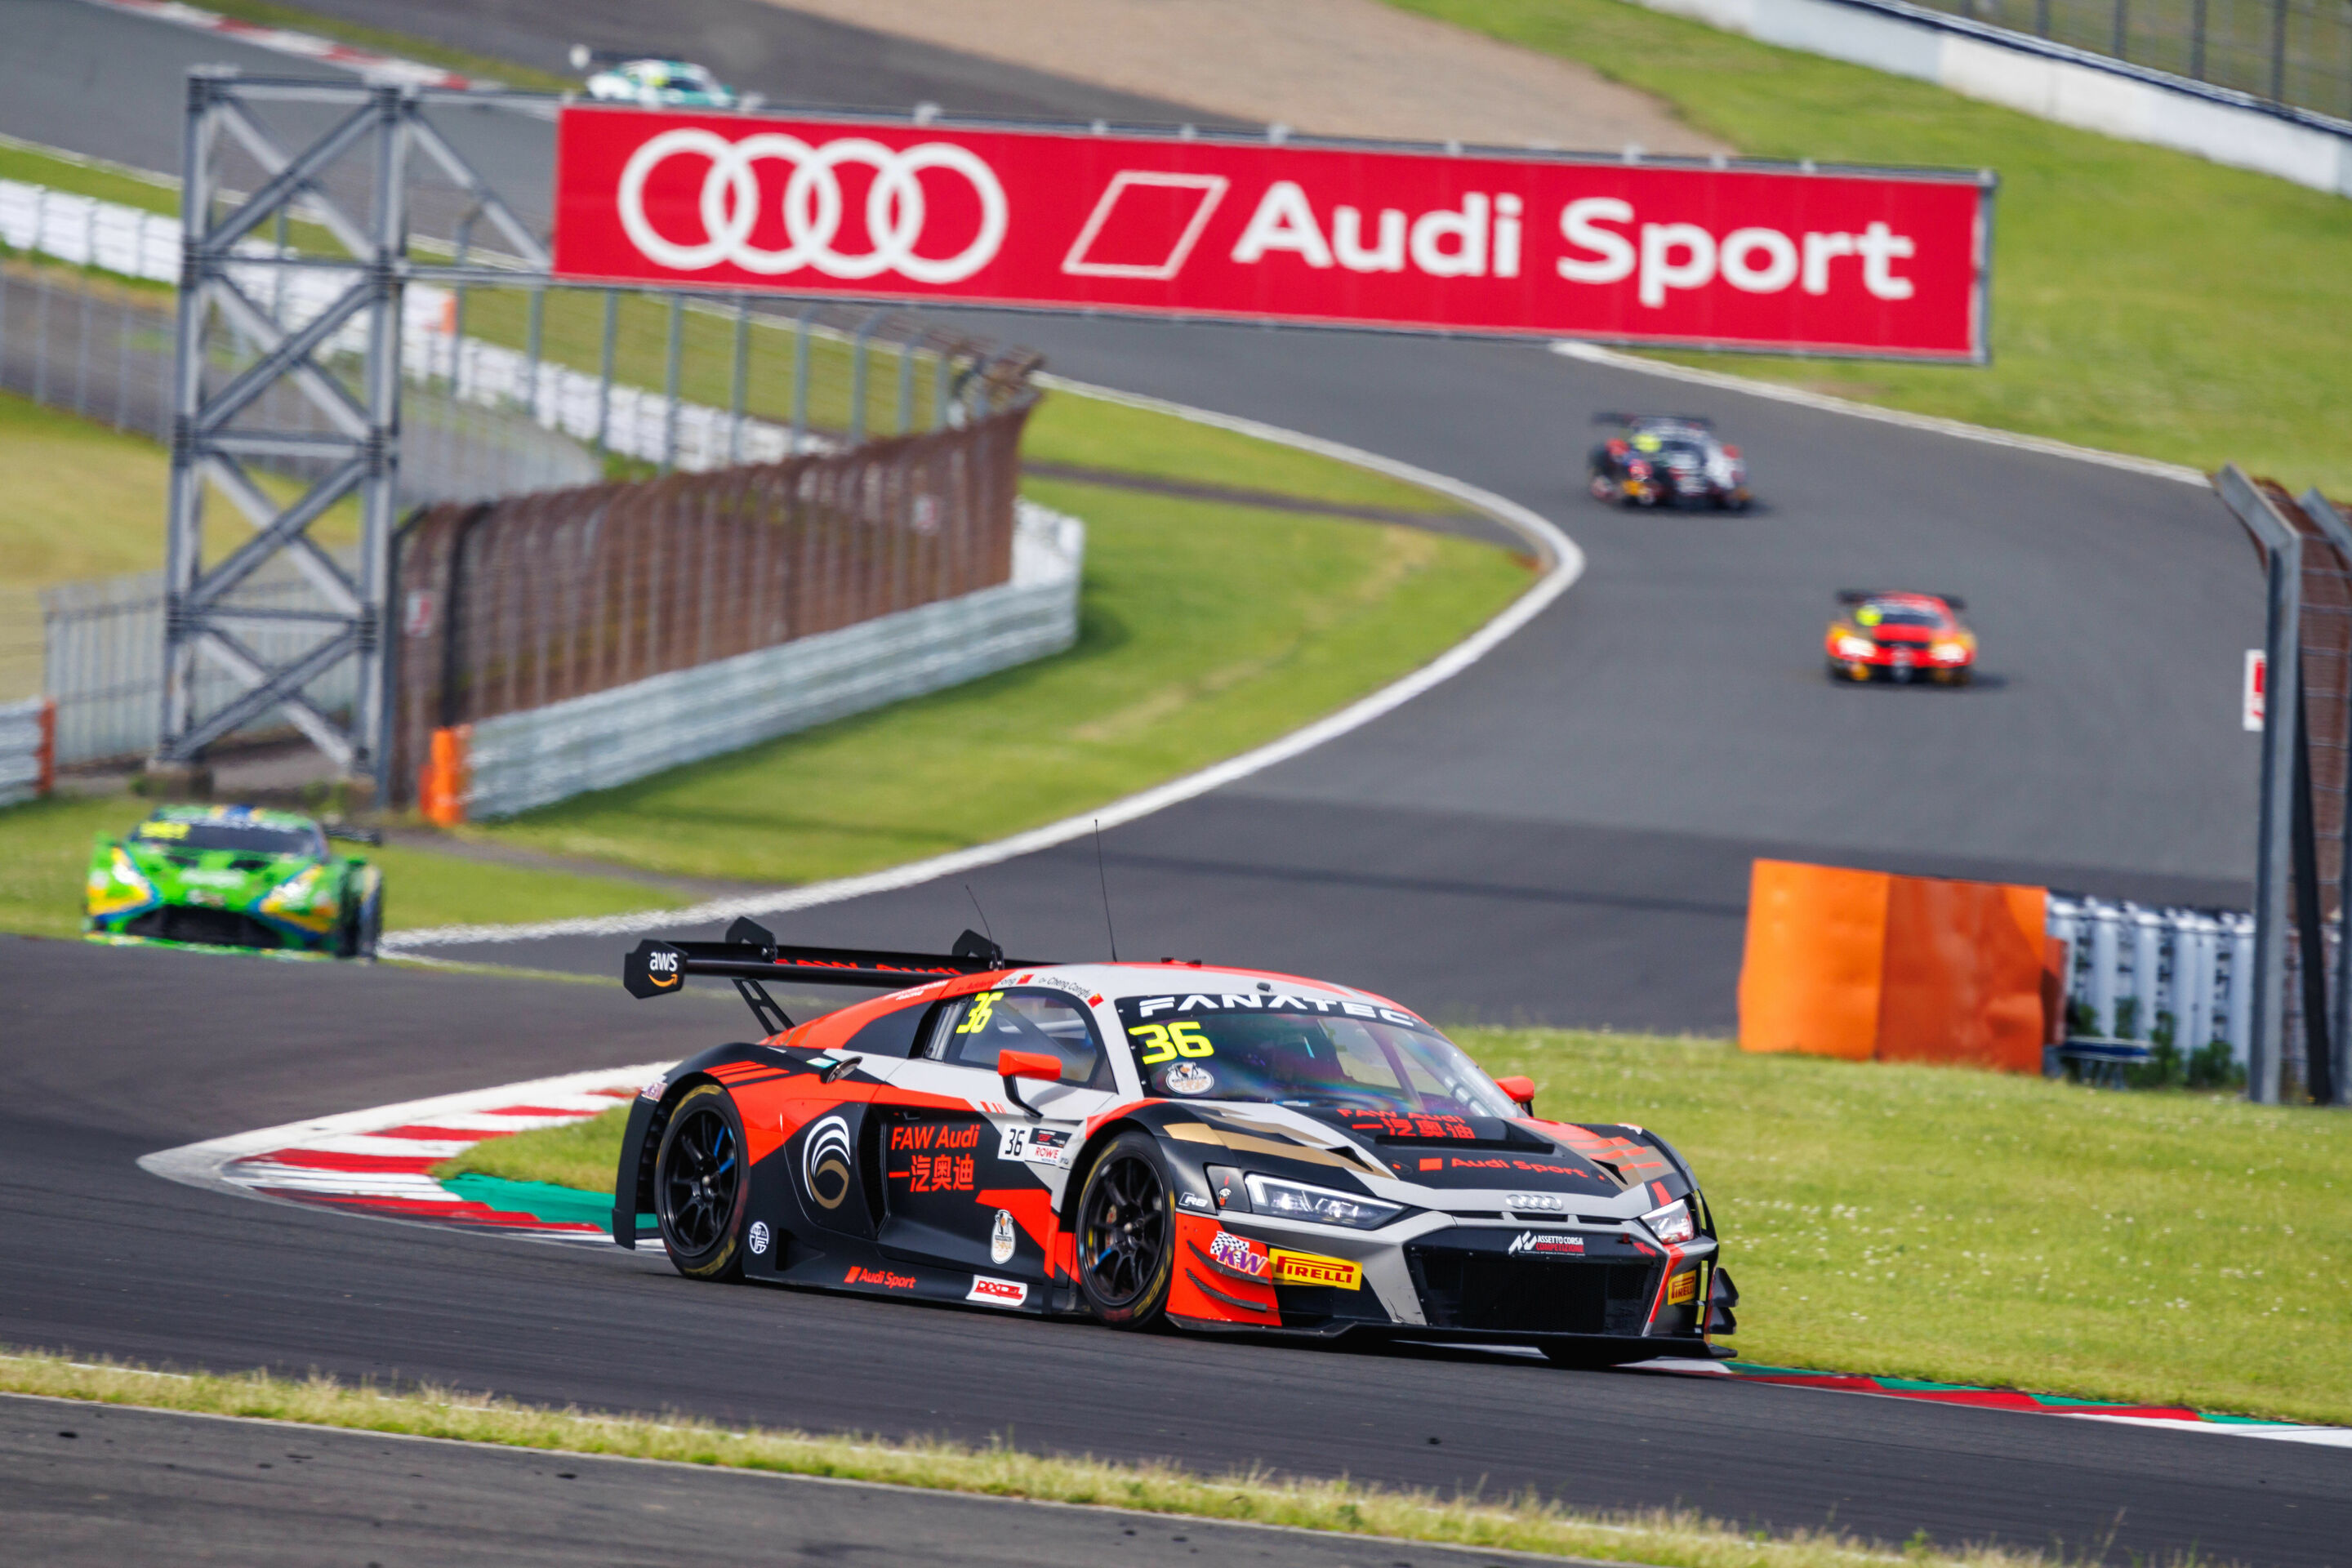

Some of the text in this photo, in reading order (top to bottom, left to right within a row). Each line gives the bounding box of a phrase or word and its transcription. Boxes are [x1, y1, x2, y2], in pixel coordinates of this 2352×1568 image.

[1232, 181, 1913, 307] Audi Sport
[649, 951, 678, 972] aws
[956, 991, 1004, 1034] 36
[1139, 994, 1414, 1027] FANATEC
[1128, 1021, 1214, 1065] 36
[1407, 1111, 1465, 1124] Audi
[891, 1124, 981, 1150] FAW Audi
[1004, 1128, 1026, 1156] 36
[1036, 1146, 1059, 1159] ROWE
[888, 1152, 974, 1192] 一汽奥迪
[1451, 1157, 1588, 1178] Audi Sport
[1185, 1196, 1208, 1206] R8
[1537, 1236, 1584, 1245] ASSETTO CORSA
[1218, 1244, 1268, 1276] KW
[1276, 1256, 1354, 1283] PIRELLI
[858, 1268, 916, 1289] Audi Sport
[1671, 1276, 1695, 1299] PIRELLI
